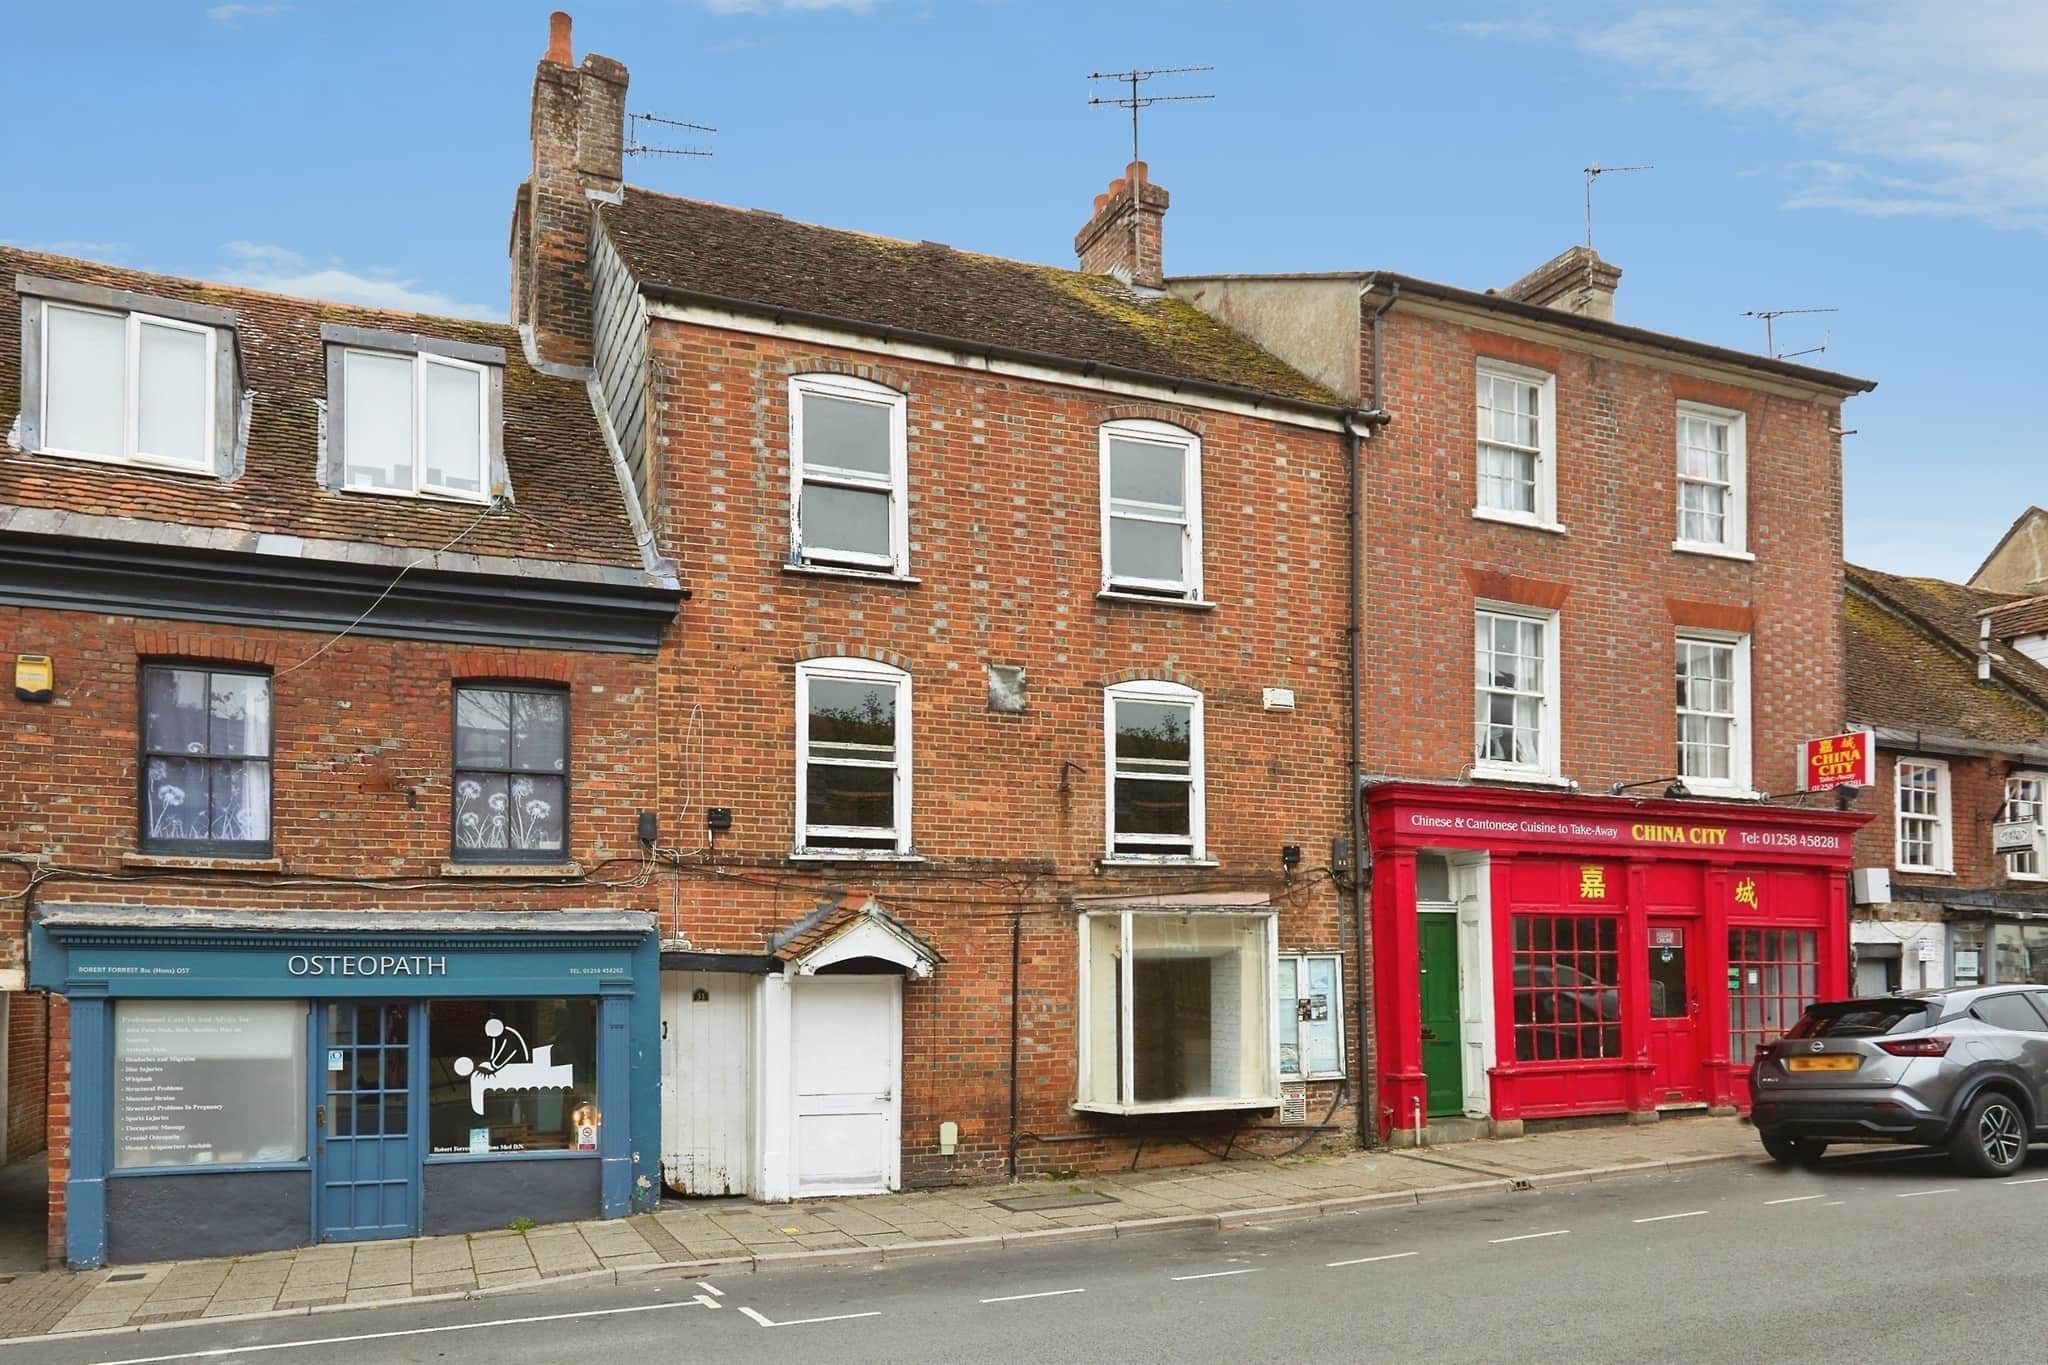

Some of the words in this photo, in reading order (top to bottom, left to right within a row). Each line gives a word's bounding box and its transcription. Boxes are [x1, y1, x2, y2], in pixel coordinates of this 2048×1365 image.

[1811, 749, 1862, 766] CHINA
[1818, 761, 1855, 776] CITY
[1411, 815, 1453, 828] Chinese
[1454, 817, 1465, 828] &
[1466, 818, 1518, 832] Cantonese
[1520, 821, 1556, 834] Cuisine
[1558, 823, 1569, 834] to
[1570, 824, 1619, 839] Take-Away
[1631, 824, 1686, 843] CHINA
[1689, 827, 1728, 845] CITY
[1740, 831, 1760, 845] Tel:
[1762, 833, 1797, 846] 01258
[1799, 835, 1840, 849] 458281
[1580, 864, 1606, 899] 嘉
[1735, 876, 1759, 911] 城
[107, 966, 138, 974] FORREST
[176, 967, 190, 975] OST
[287, 955, 447, 976] OSTEOPATH
[157, 1084, 184, 1092] Problems
